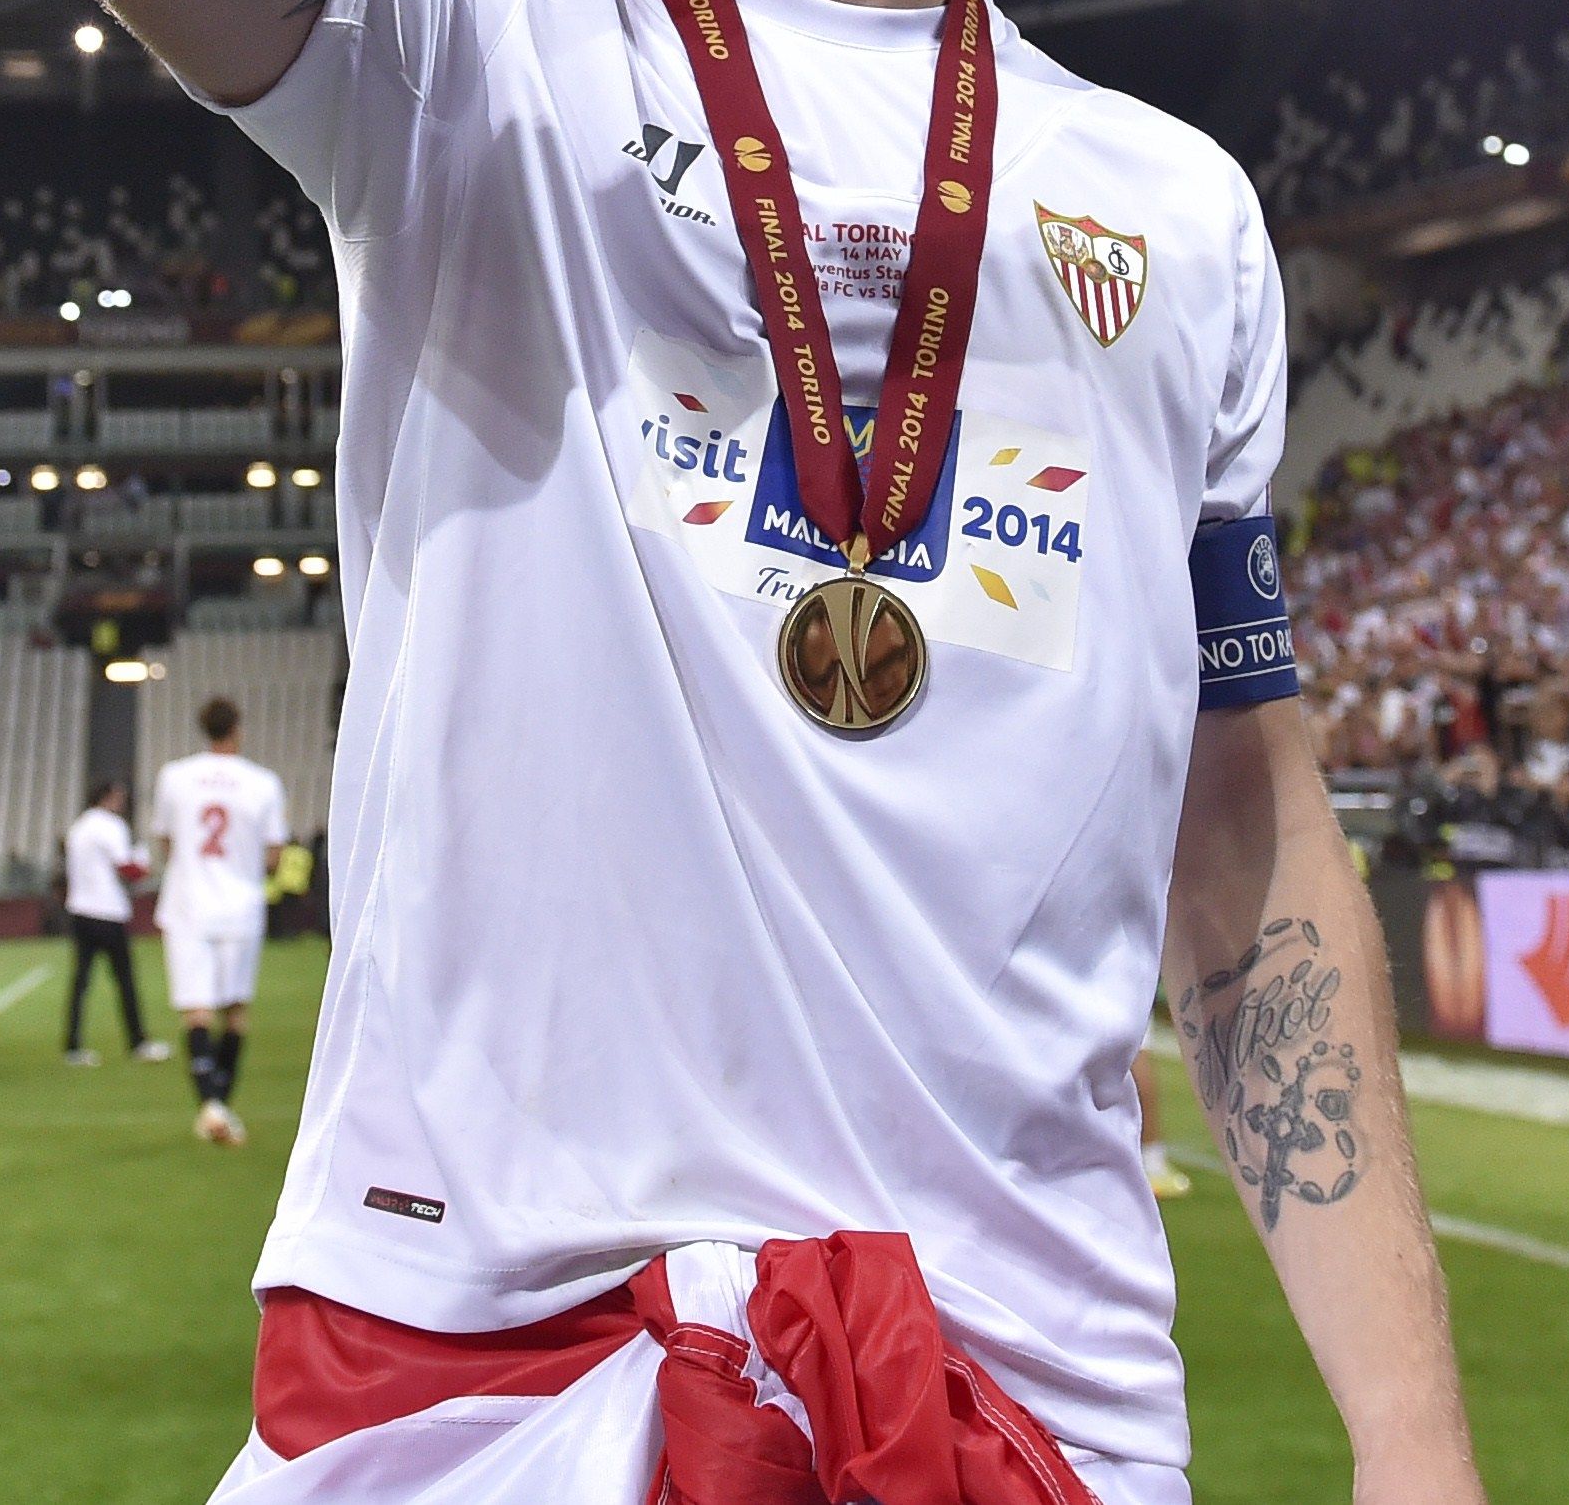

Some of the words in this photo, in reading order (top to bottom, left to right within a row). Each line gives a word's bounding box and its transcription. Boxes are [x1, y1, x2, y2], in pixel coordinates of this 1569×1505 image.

[956, 59, 977, 109] 2014
[949, 112, 973, 164] FINAL
[802, 223, 827, 242] AL
[840, 247, 860, 261] 14
[865, 247, 902, 261] MAY
[833, 281, 854, 298] FC
[858, 287, 876, 299] vs
[755, 198, 788, 263] FINAL
[774, 271, 806, 332] 2014
[794, 344, 831, 445] TORINO
[912, 287, 949, 378] TORINO
[899, 391, 929, 455] 2014
[881, 460, 914, 532] FINAL
[961, 496, 1083, 564] 2014
[1199, 638, 1244, 672] NO
[1246, 632, 1276, 664] TO
[1276, 628, 1295, 658] RA
[200, 804, 229, 858] 2
[411, 1202, 442, 1218] TECH
